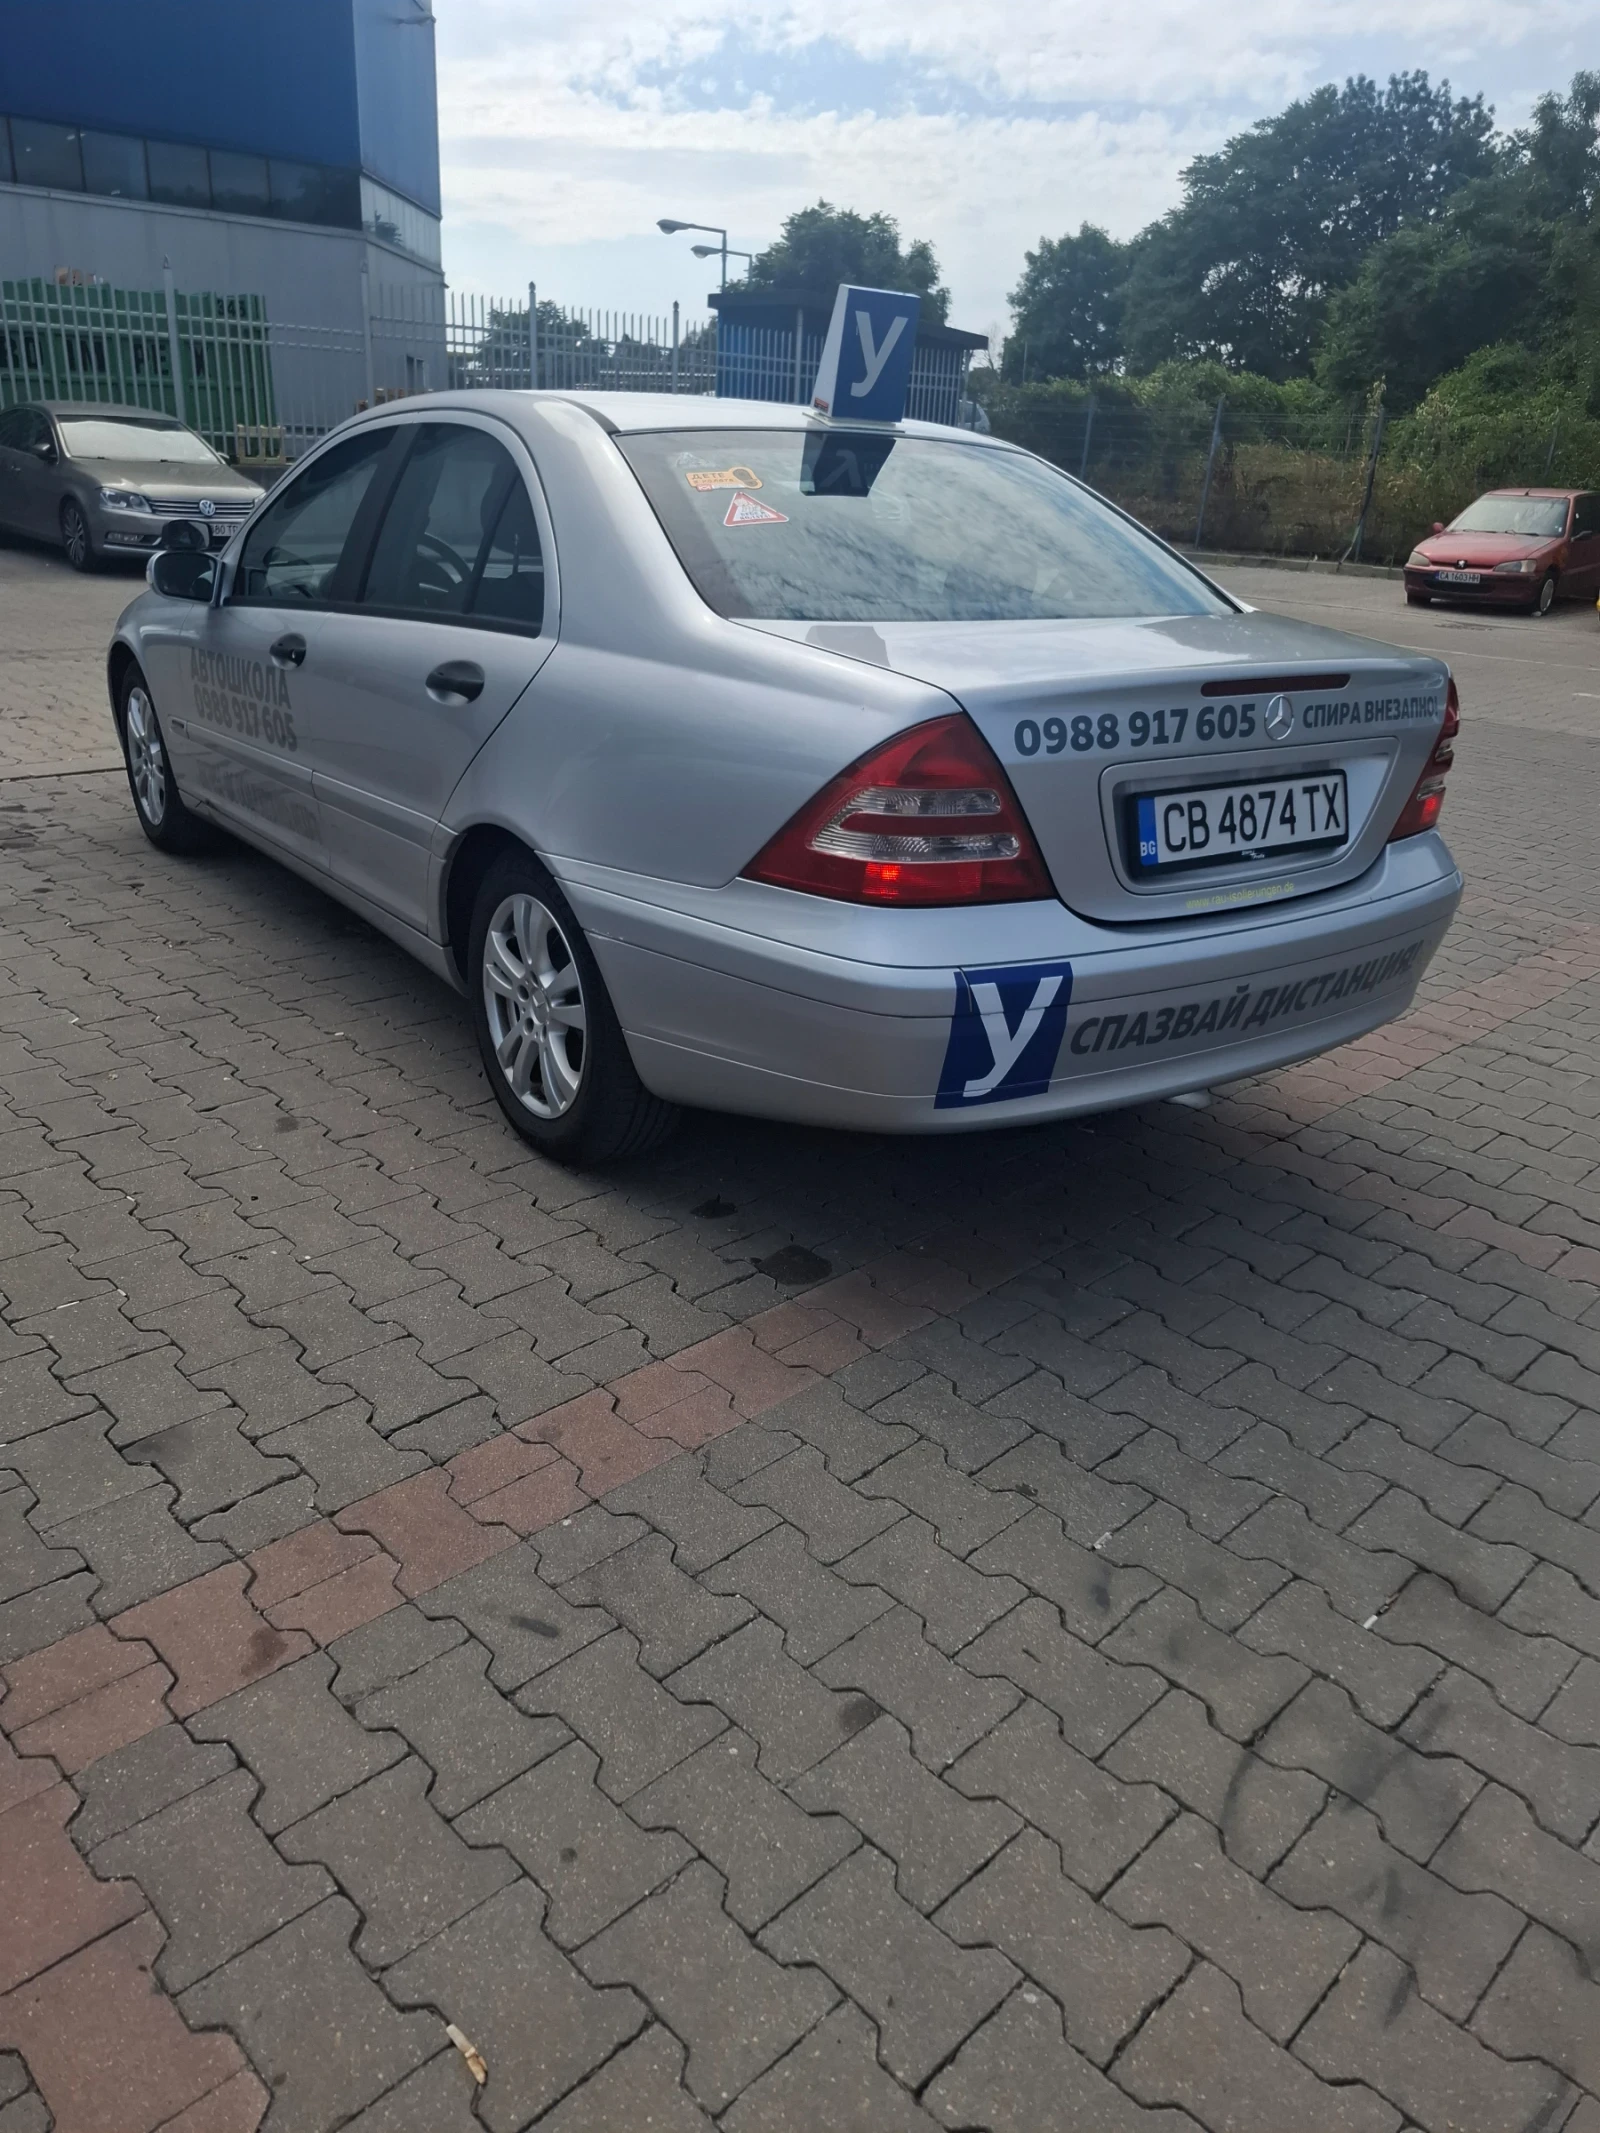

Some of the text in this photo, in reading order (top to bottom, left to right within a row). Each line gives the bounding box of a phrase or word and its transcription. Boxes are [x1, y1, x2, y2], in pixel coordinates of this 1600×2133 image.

[692, 472, 726, 480] ДЕТЕ
[190, 647, 292, 709] АВТОШКОЛА
[193, 683, 298, 752] 0988 917 605
[1014, 703, 1256, 756] 0988 917 605
[1302, 696, 1438, 728] СПИРА ВНЕЗАПНО!
[1163, 782, 1340, 852] CB 4874 TX
[1140, 840, 1156, 857] BG
[1070, 939, 1424, 1055] СПАЗВАЙ ДИСТАНЦИЯ!
